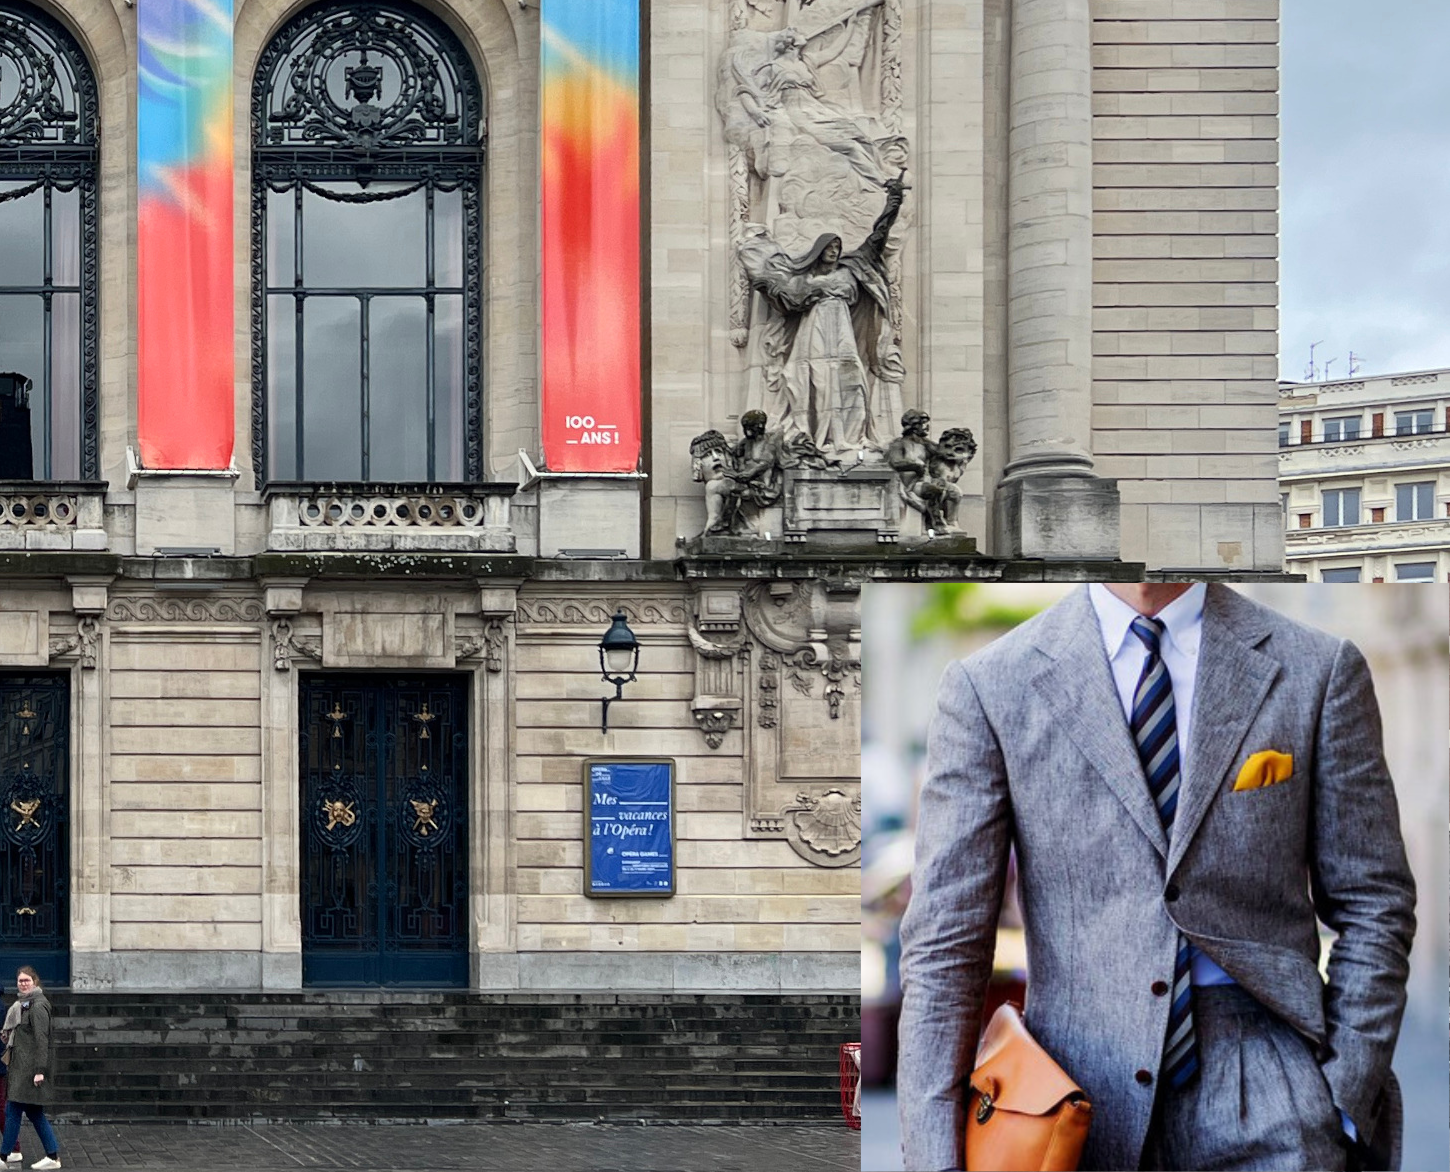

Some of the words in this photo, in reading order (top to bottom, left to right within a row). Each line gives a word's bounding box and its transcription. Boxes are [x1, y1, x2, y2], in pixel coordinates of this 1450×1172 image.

[566, 416, 595, 428] 100
[593, 793, 618, 805] Mes
[618, 811, 668, 821] vacances
[593, 824, 600, 836] à
